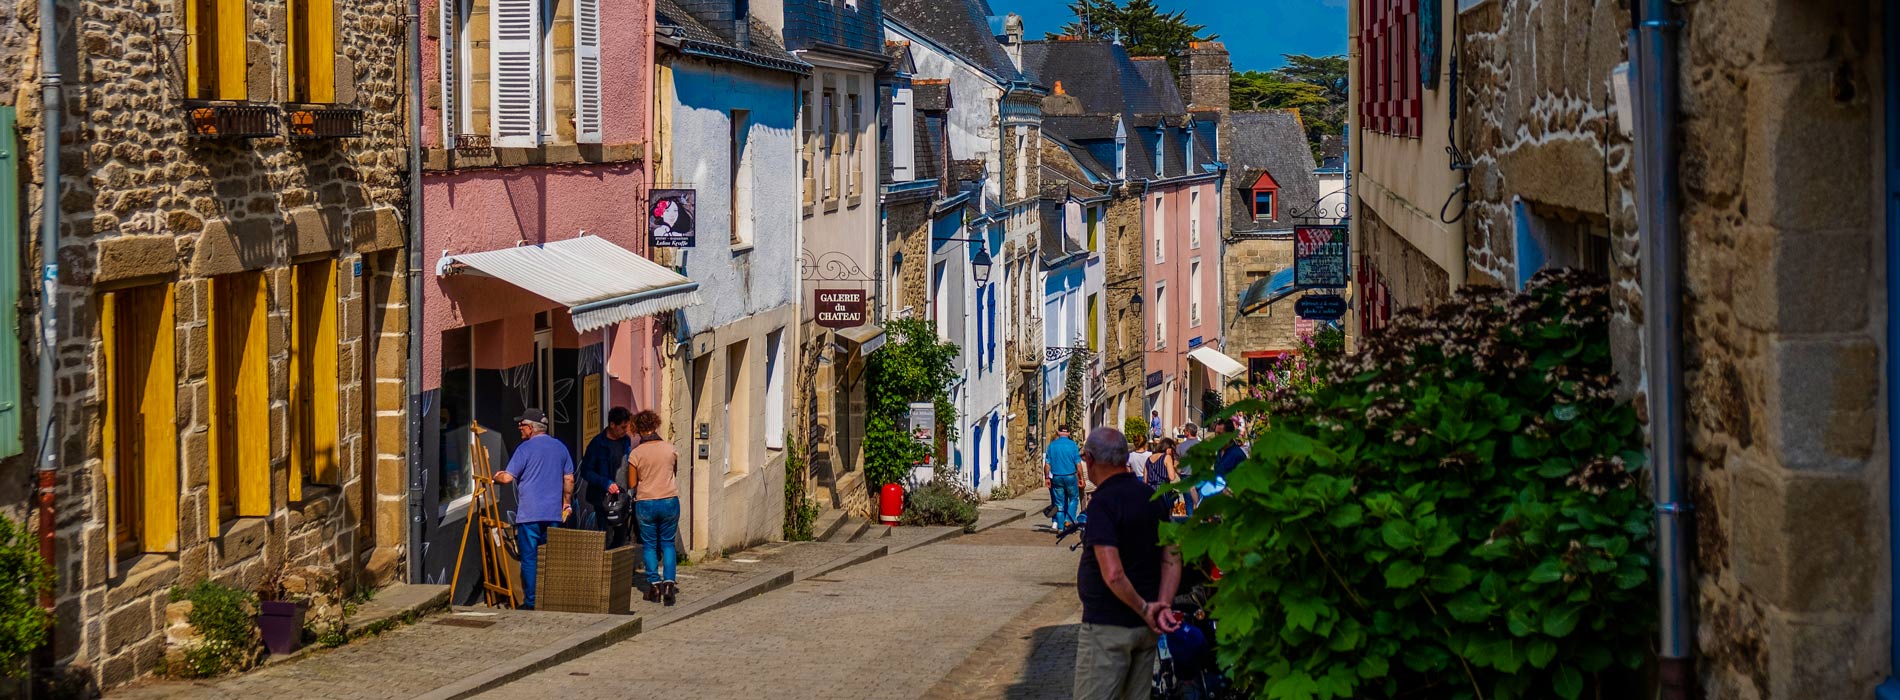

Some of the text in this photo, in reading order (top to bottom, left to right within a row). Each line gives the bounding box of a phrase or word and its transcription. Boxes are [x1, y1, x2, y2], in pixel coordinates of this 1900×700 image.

[1298, 242, 1343, 255] GINETTE
[820, 294, 860, 302] GALERIE
[835, 303, 846, 311] du
[818, 312, 861, 321] CHATEAU
